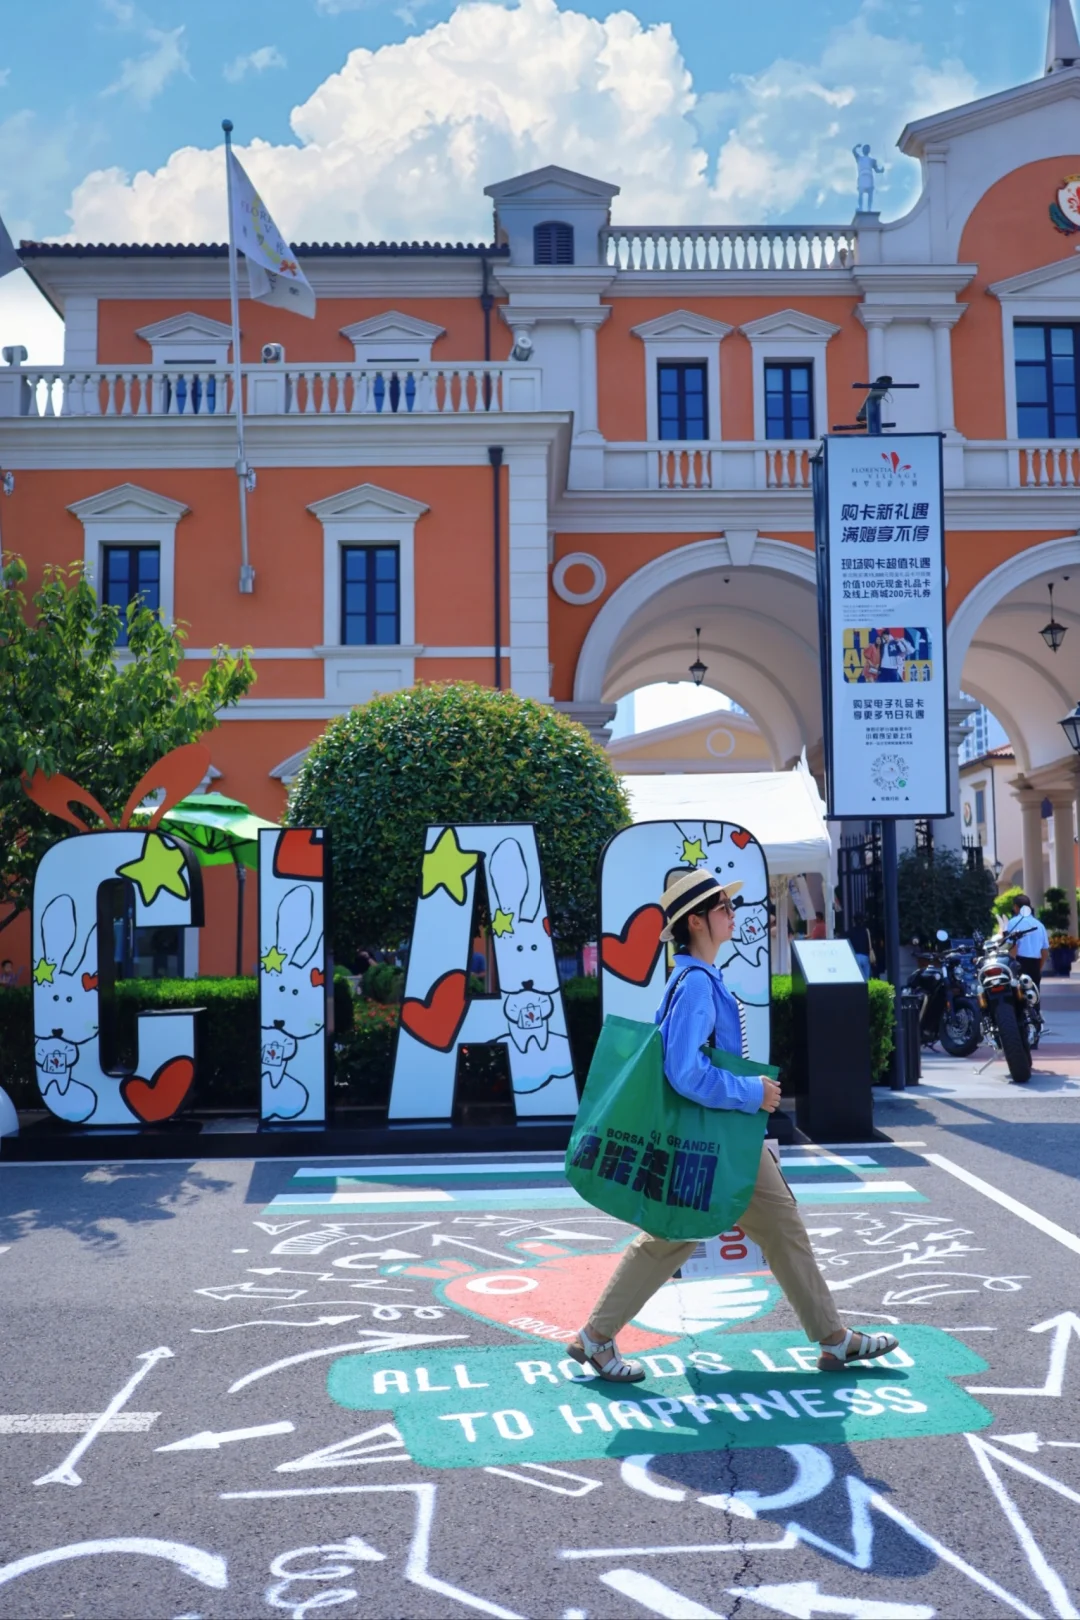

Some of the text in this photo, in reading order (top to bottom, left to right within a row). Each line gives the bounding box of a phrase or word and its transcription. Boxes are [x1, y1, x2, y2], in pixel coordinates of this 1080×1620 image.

[841, 502, 930, 521] 购卡新礼遇
[841, 525, 930, 543] 满赠享不停
[841, 557, 931, 570] 现场购卡超值礼遇
[842, 579, 931, 589] 价值100元现金礼品卡
[842, 589, 931, 599] 及线上商城200元礼券
[853, 699, 924, 709] 购买电子礼品卡
[854, 710, 925, 720] 享更多节日礼遇
[33, 820, 771, 1127] CIAO
[606, 1128, 645, 1147] BORSA
[373, 1347, 915, 1394] ALL RODS LED
[438, 1386, 928, 1442] TO HAPPINESS
